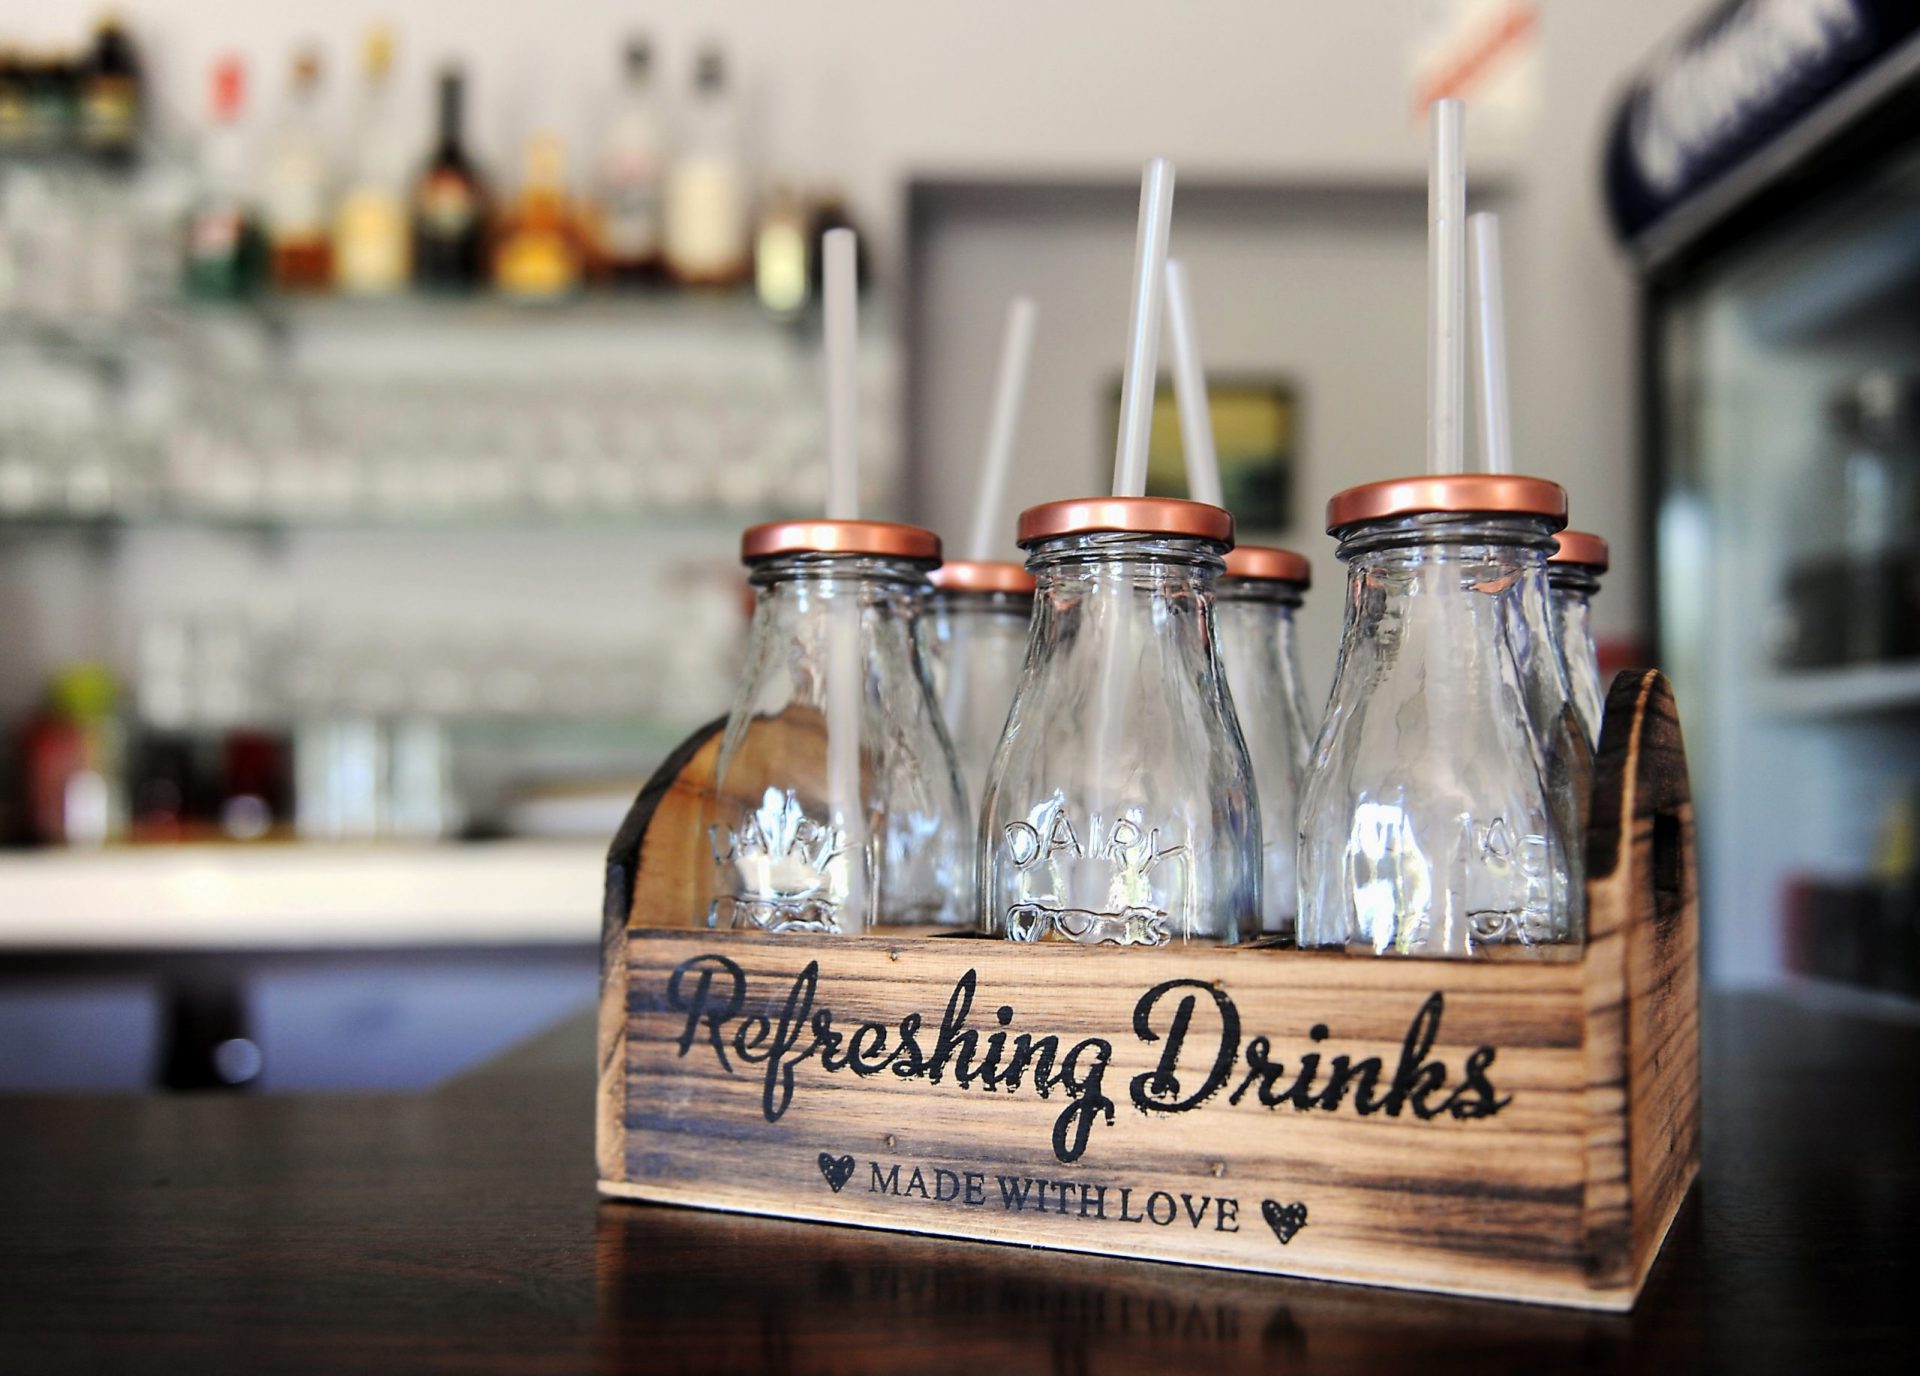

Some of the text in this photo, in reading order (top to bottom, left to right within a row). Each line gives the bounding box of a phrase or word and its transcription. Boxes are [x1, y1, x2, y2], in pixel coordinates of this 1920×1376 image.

[667, 954, 1512, 1163] Refreshing Drinks
[868, 1161, 1240, 1233] MADE WITH LOVE
